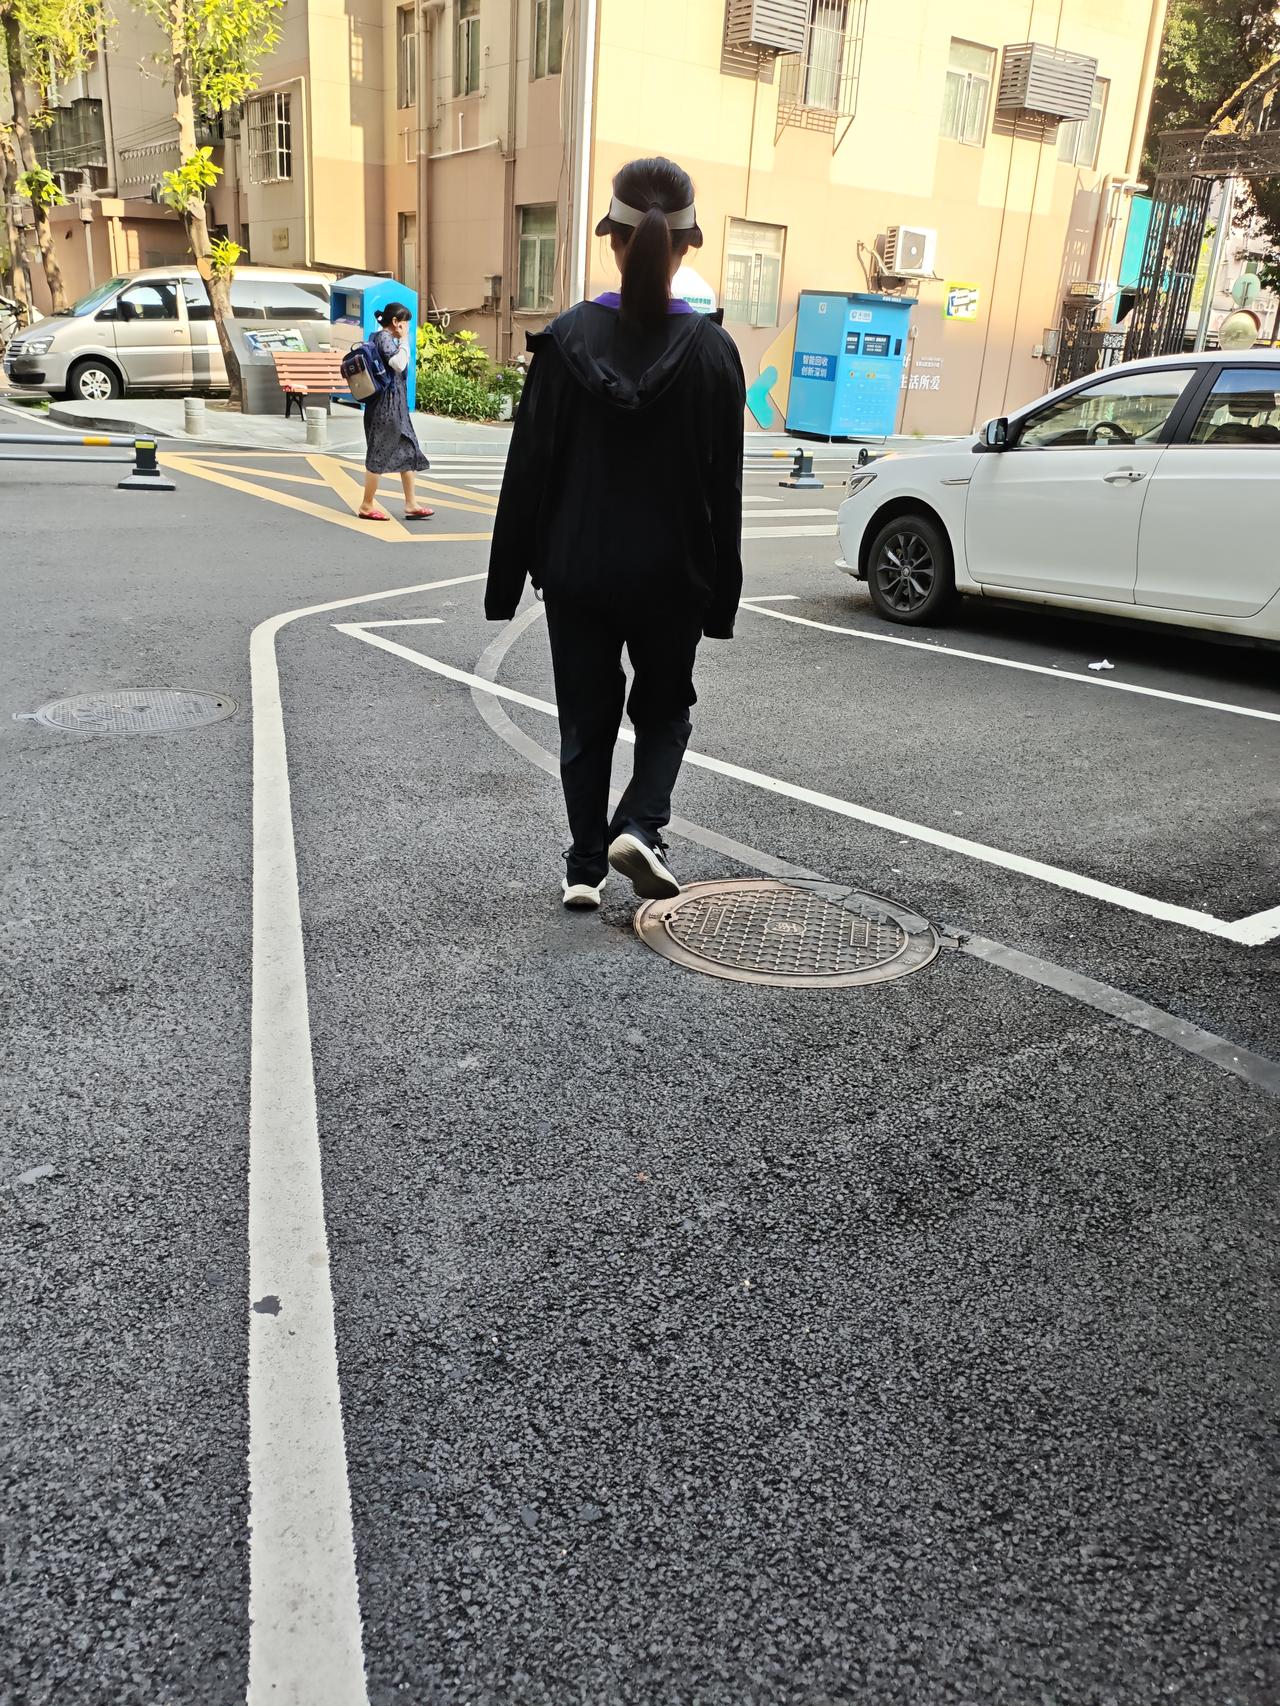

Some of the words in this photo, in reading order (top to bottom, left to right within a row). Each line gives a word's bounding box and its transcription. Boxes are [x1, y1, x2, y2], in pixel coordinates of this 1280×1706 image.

[802, 354, 828, 367] 智能回收
[801, 366, 828, 379] 创新深圳
